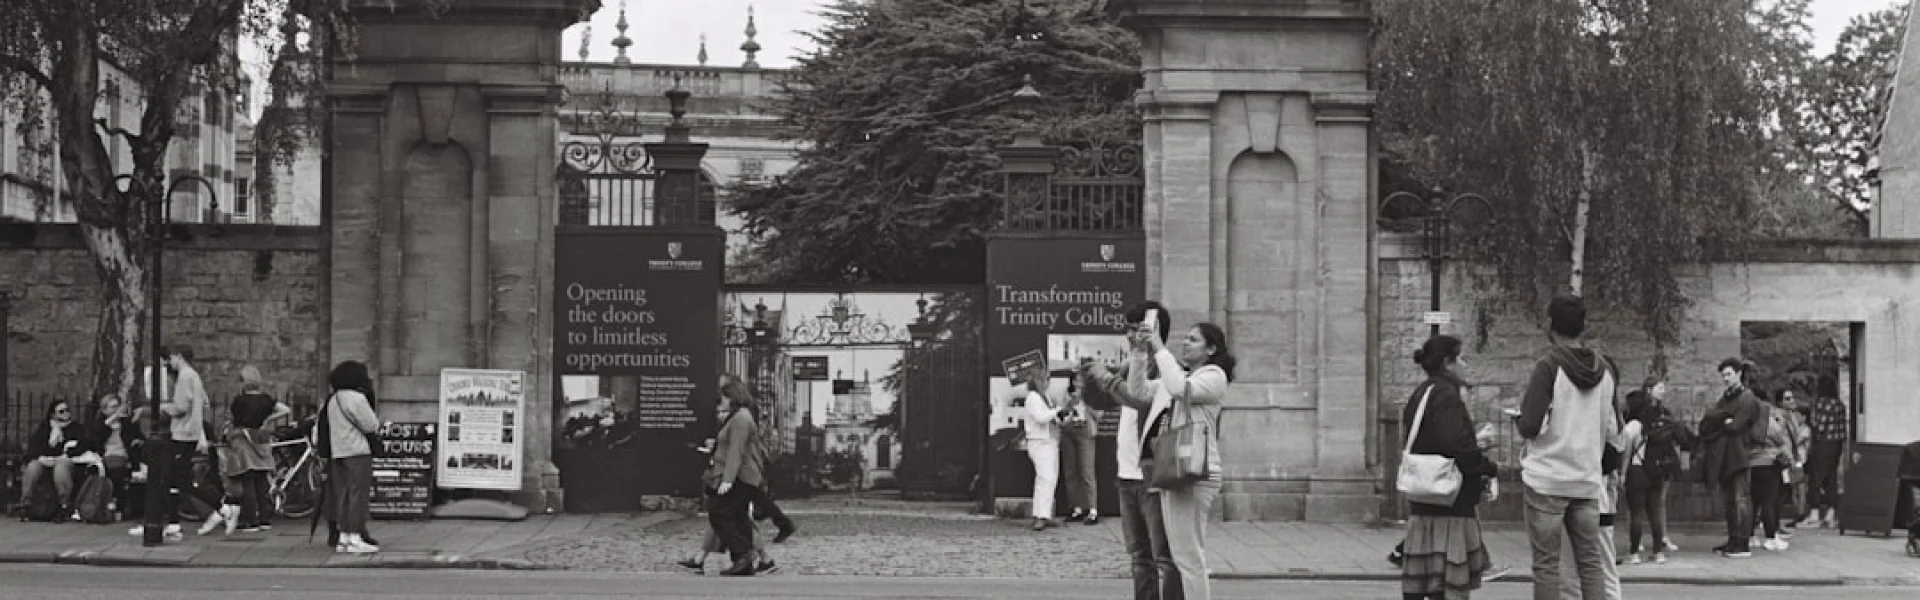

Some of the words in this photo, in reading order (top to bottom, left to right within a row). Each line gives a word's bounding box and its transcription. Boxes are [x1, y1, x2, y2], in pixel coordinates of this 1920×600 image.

[566, 283, 647, 306] Opening
[995, 284, 1123, 308] Transforming
[568, 304, 597, 324] the
[602, 304, 655, 324] doors
[995, 306, 1059, 330] Trinity
[1065, 306, 1128, 331] Colleg
[568, 330, 588, 346] to
[593, 326, 668, 346] limitless
[566, 348, 691, 372] opportunities
[382, 439, 433, 455] TOURS
